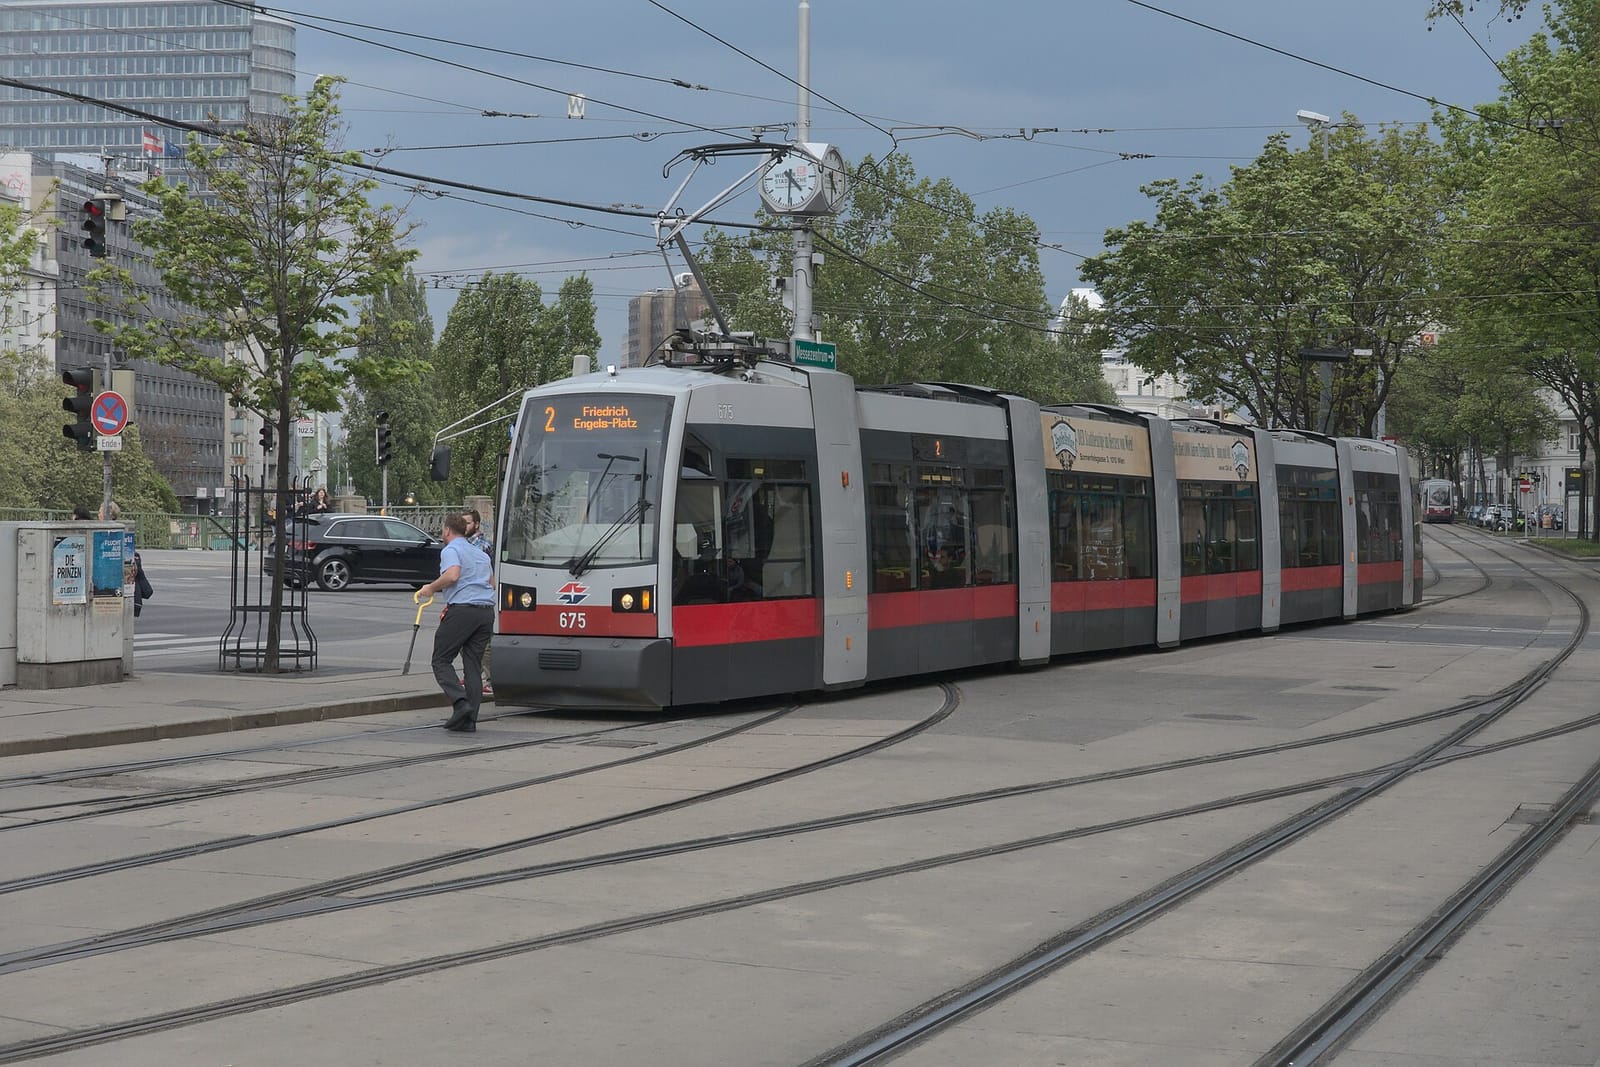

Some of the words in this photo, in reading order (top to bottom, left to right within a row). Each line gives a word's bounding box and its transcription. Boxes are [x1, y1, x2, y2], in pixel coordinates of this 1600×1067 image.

[569, 96, 584, 115] W
[796, 345, 828, 362] Messezentrum
[545, 406, 555, 432] 2
[583, 406, 628, 417] Friedrich
[574, 418, 638, 431] Engels-Platz
[102, 440, 117, 448] Ende
[65, 554, 75, 566] DIE
[57, 567, 81, 578] PRINZEN
[560, 612, 586, 629] 675
